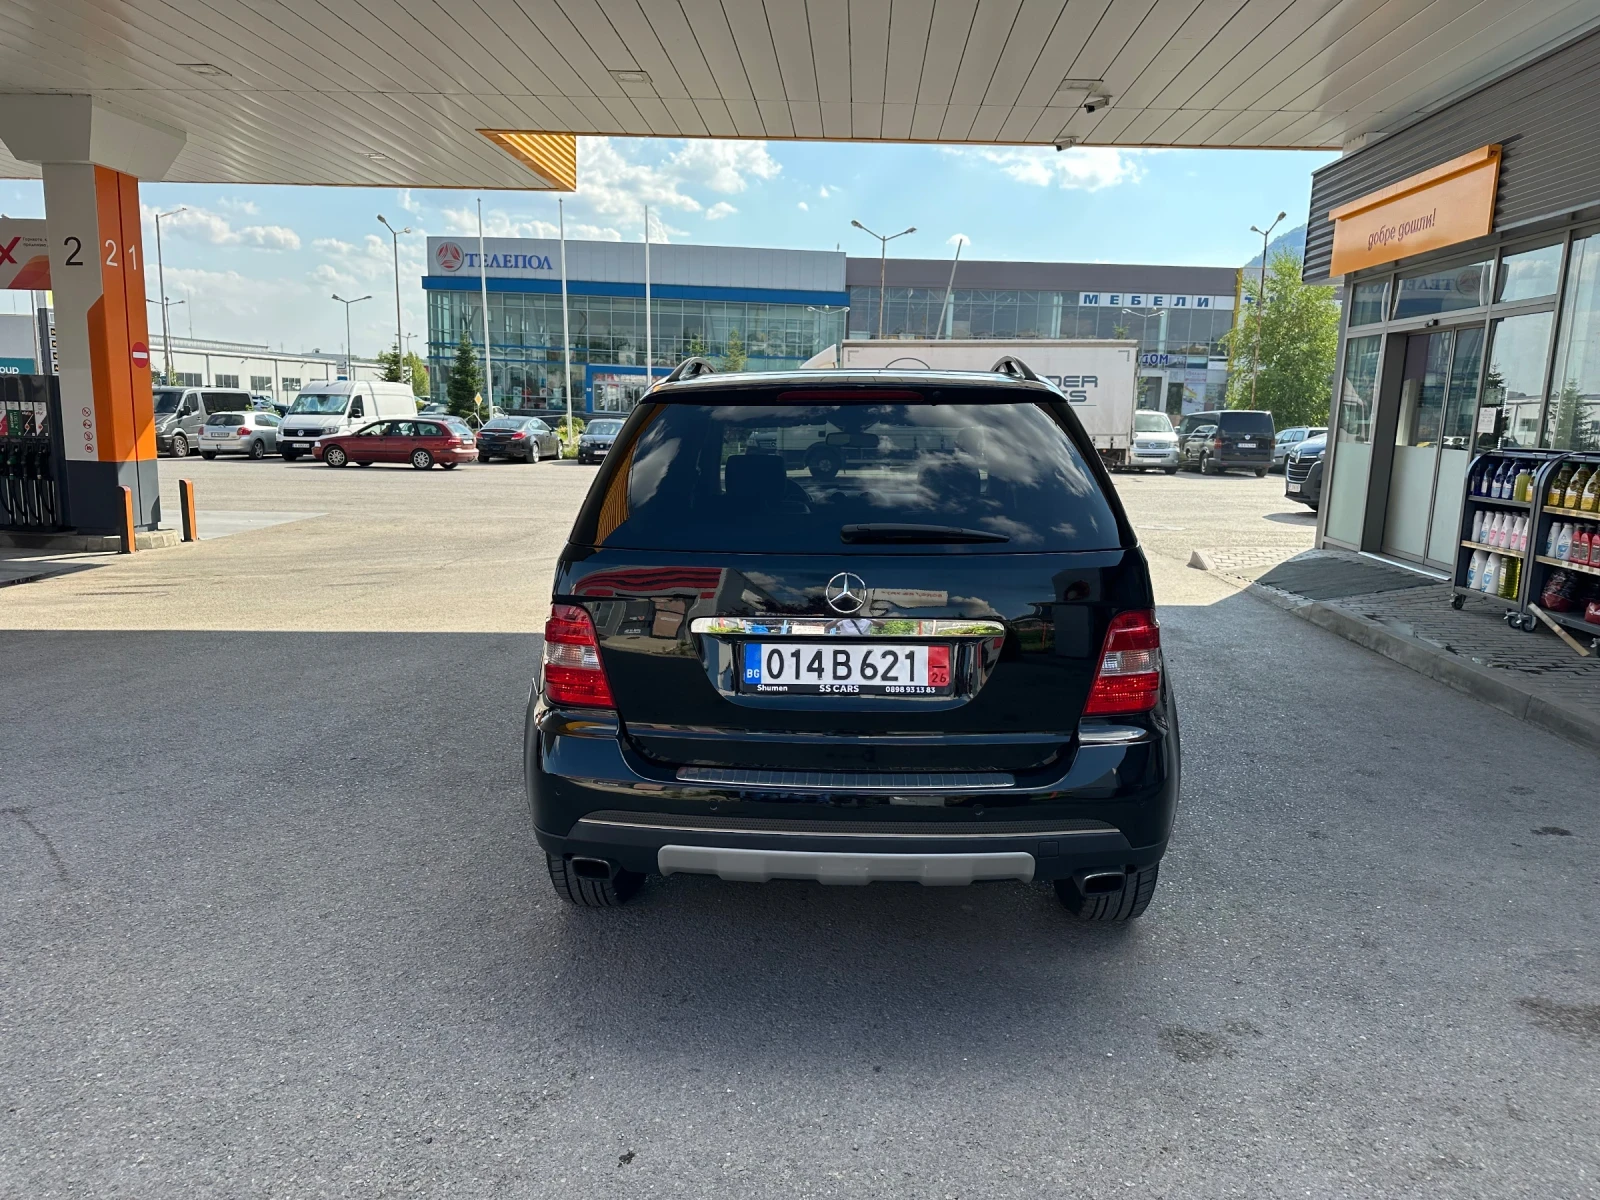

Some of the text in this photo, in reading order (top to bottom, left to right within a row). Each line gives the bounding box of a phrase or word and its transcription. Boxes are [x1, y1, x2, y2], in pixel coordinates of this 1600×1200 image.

[1367, 208, 1437, 251] добре дошли!
[63, 236, 84, 266] 2
[104, 239, 118, 267] 2
[128, 245, 137, 270] 1
[465, 253, 553, 270] ТЕЛЕПОЛ
[1083, 293, 1210, 308] МЕБЕЛИ
[746, 668, 760, 679] BG
[931, 672, 947, 683] 26
[756, 684, 788, 692] Shumen
[819, 684, 860, 693] SS CARS
